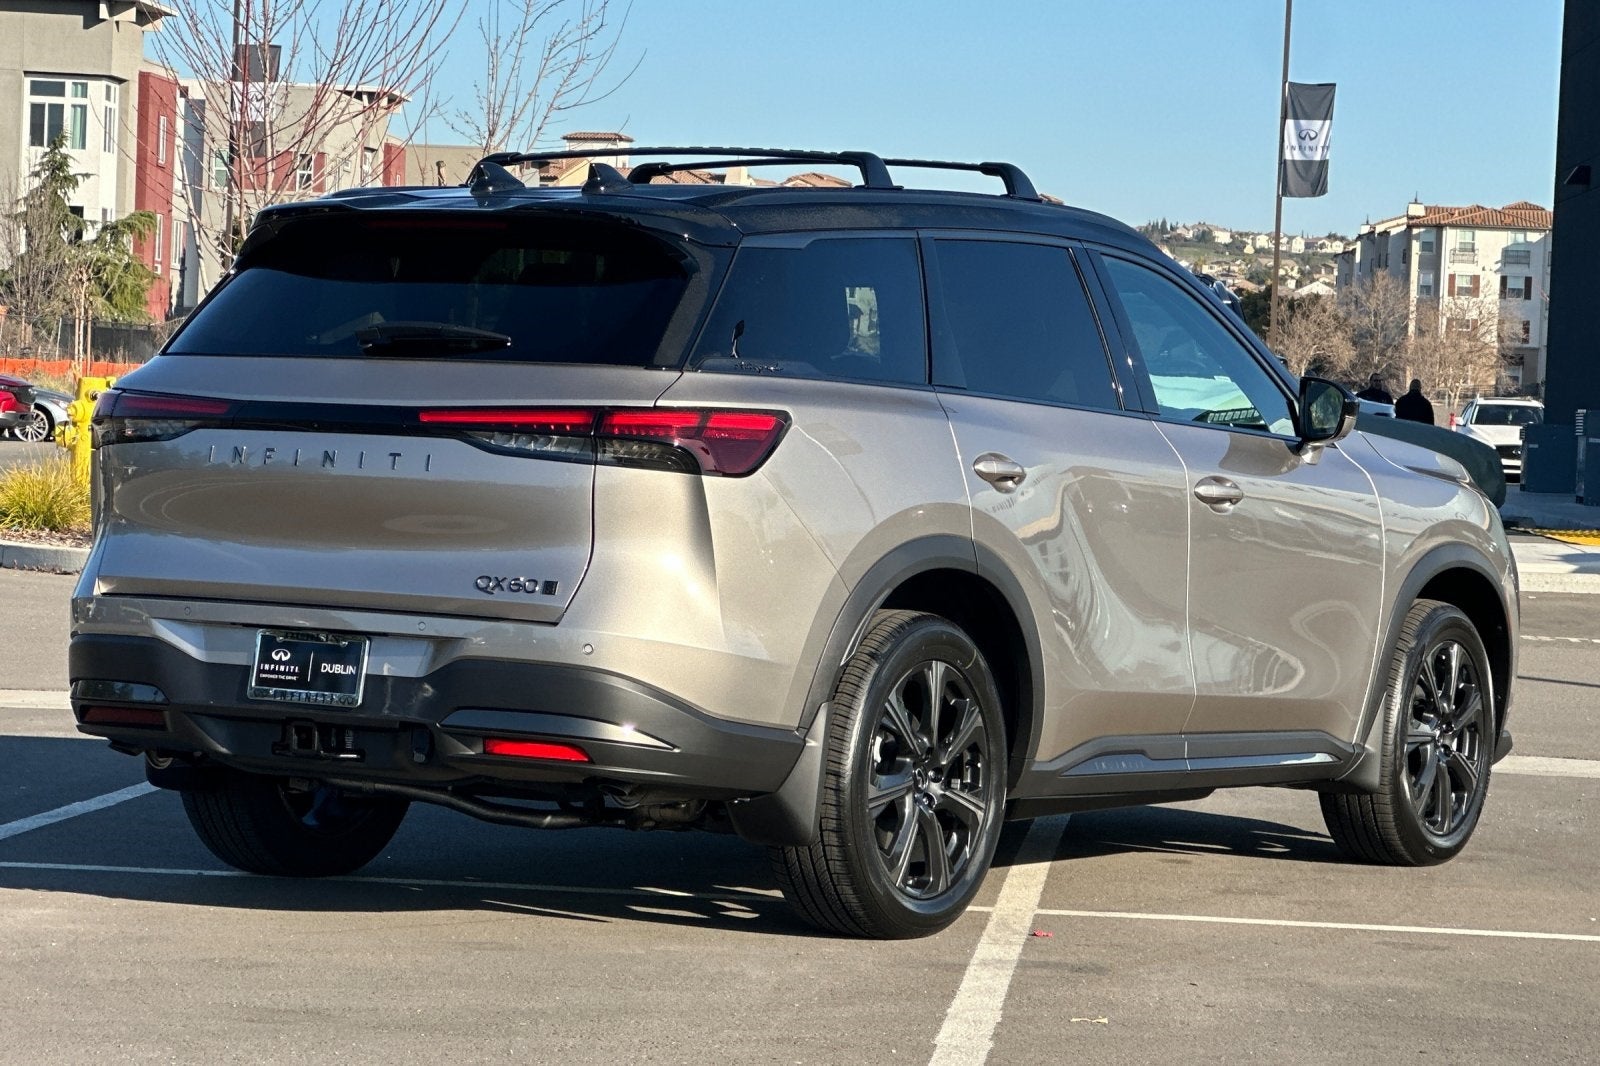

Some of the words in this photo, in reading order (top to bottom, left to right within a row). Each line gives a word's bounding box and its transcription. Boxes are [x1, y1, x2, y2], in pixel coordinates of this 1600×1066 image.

[208, 445, 432, 472] INFINITI
[474, 575, 540, 595] QX60
[260, 663, 299, 673] INFINITI
[321, 663, 356, 674] DUBLIN
